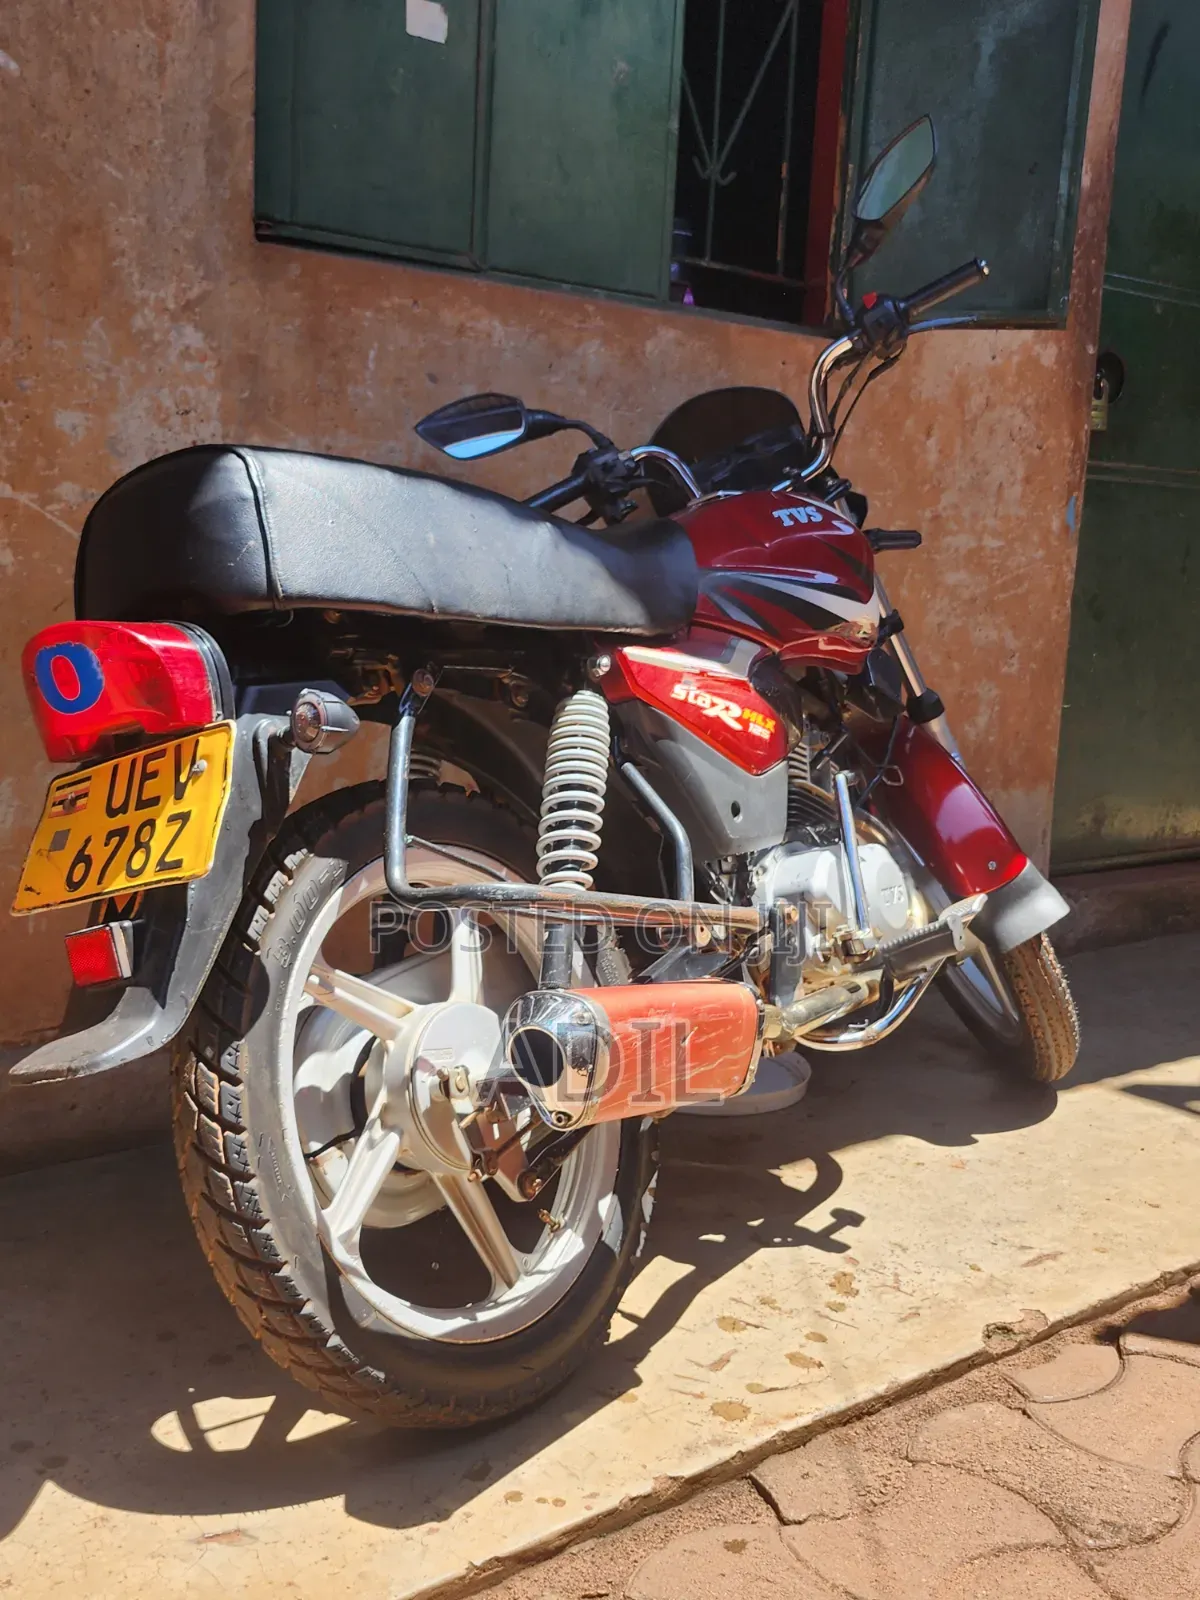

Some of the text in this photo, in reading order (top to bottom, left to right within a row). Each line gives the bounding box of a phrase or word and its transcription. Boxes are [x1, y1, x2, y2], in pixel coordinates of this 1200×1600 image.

[772, 505, 823, 527] TVS
[748, 721, 771, 740] 125
[105, 738, 201, 819] UEV
[65, 809, 192, 893] 678Z
